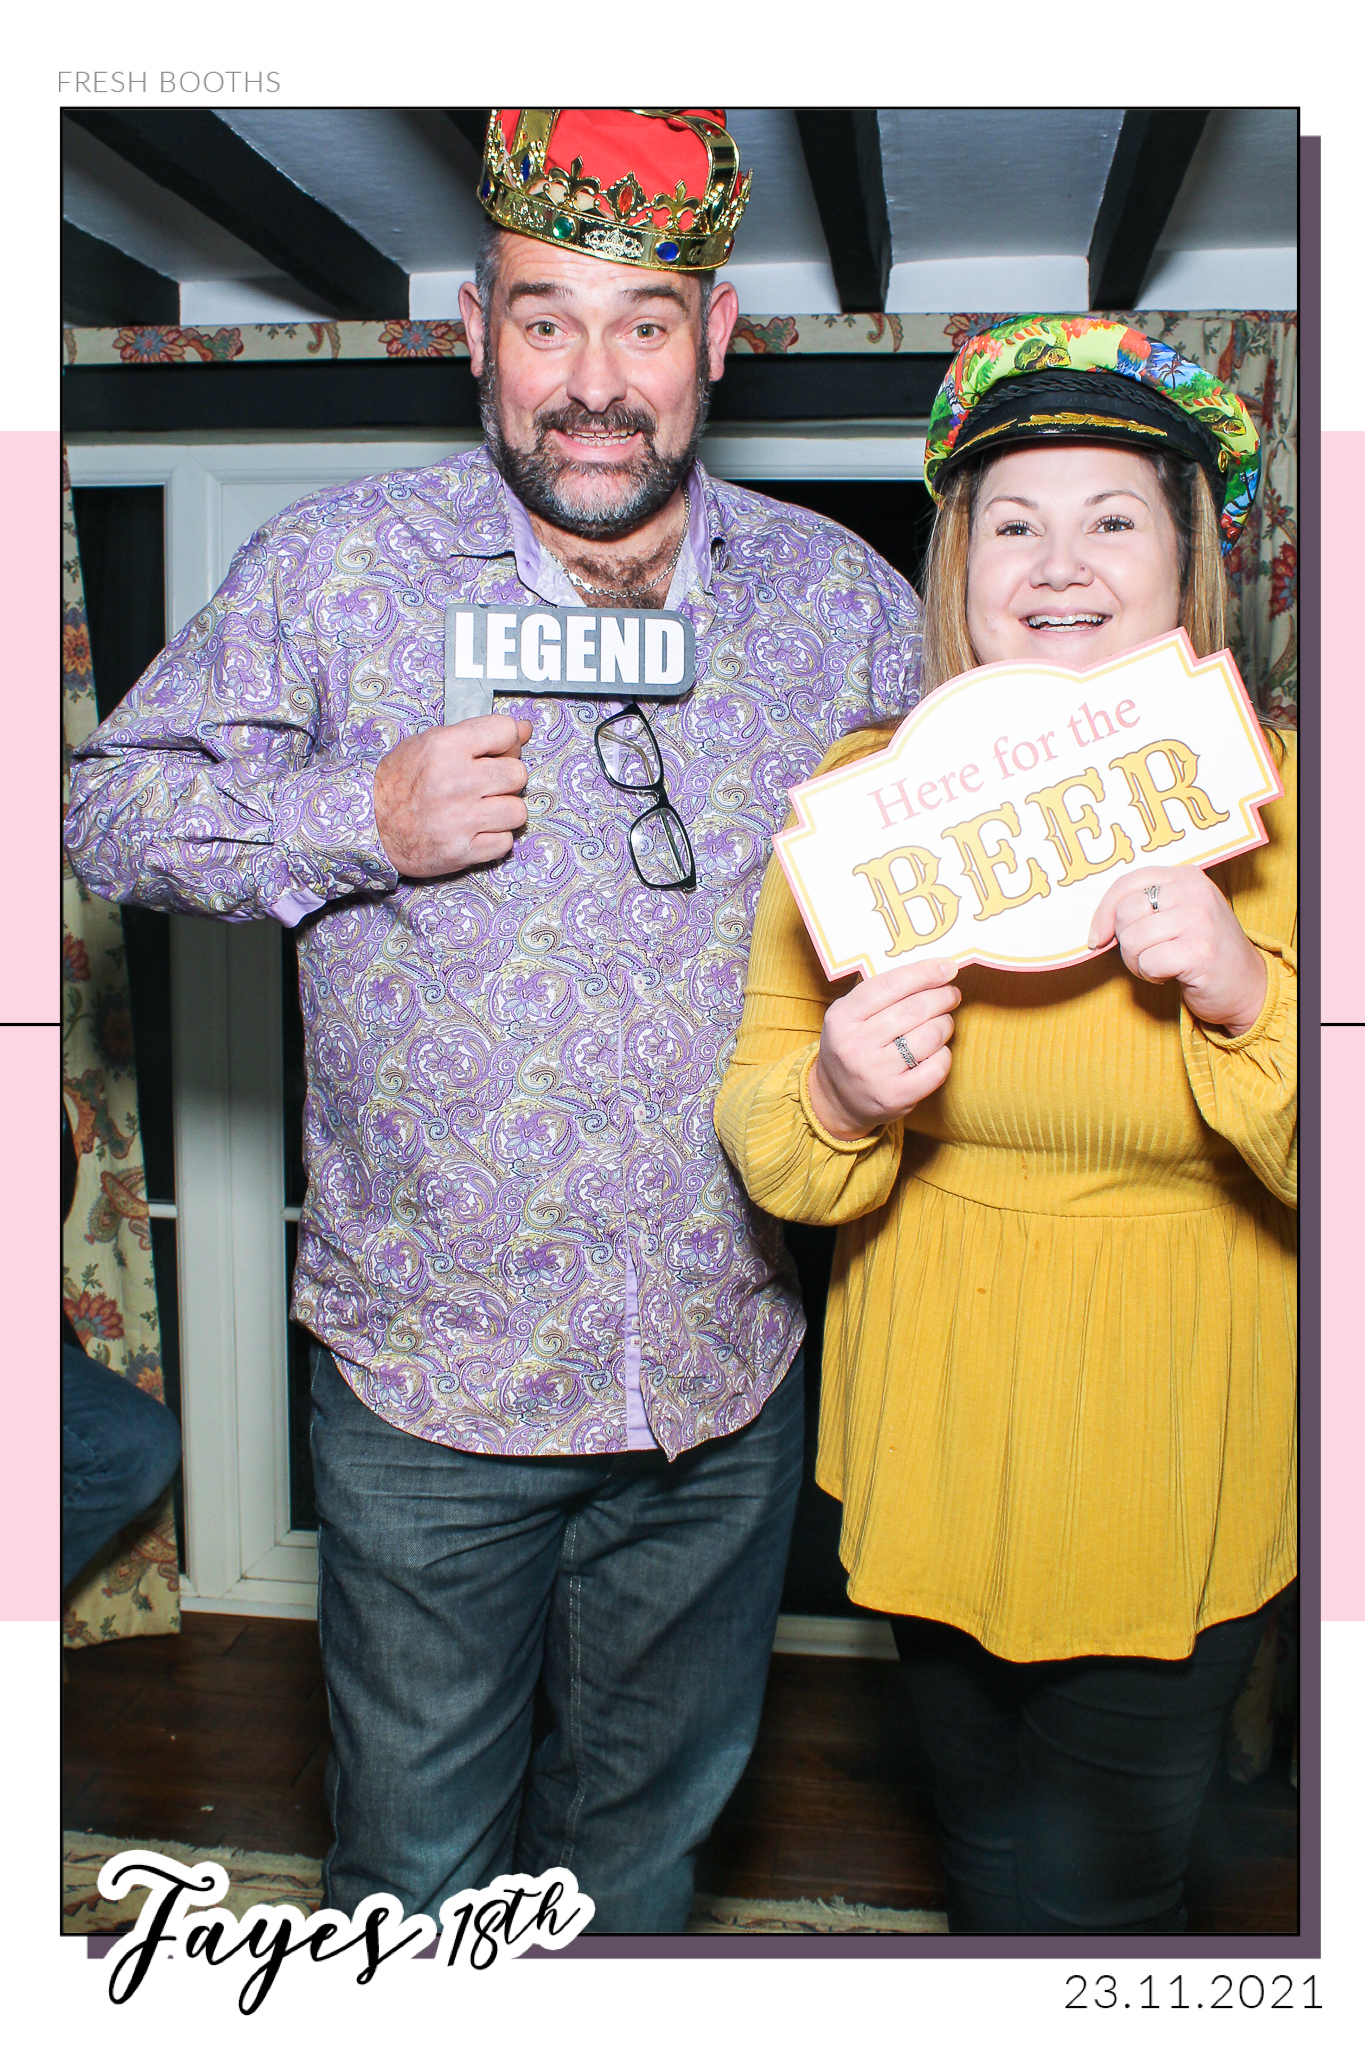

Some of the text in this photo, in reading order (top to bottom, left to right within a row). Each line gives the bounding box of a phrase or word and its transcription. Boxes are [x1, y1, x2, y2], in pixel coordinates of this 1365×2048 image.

[455, 612, 685, 685] LEGEND
[868, 697, 1142, 830] Here for the
[852, 738, 1231, 958] BEER
